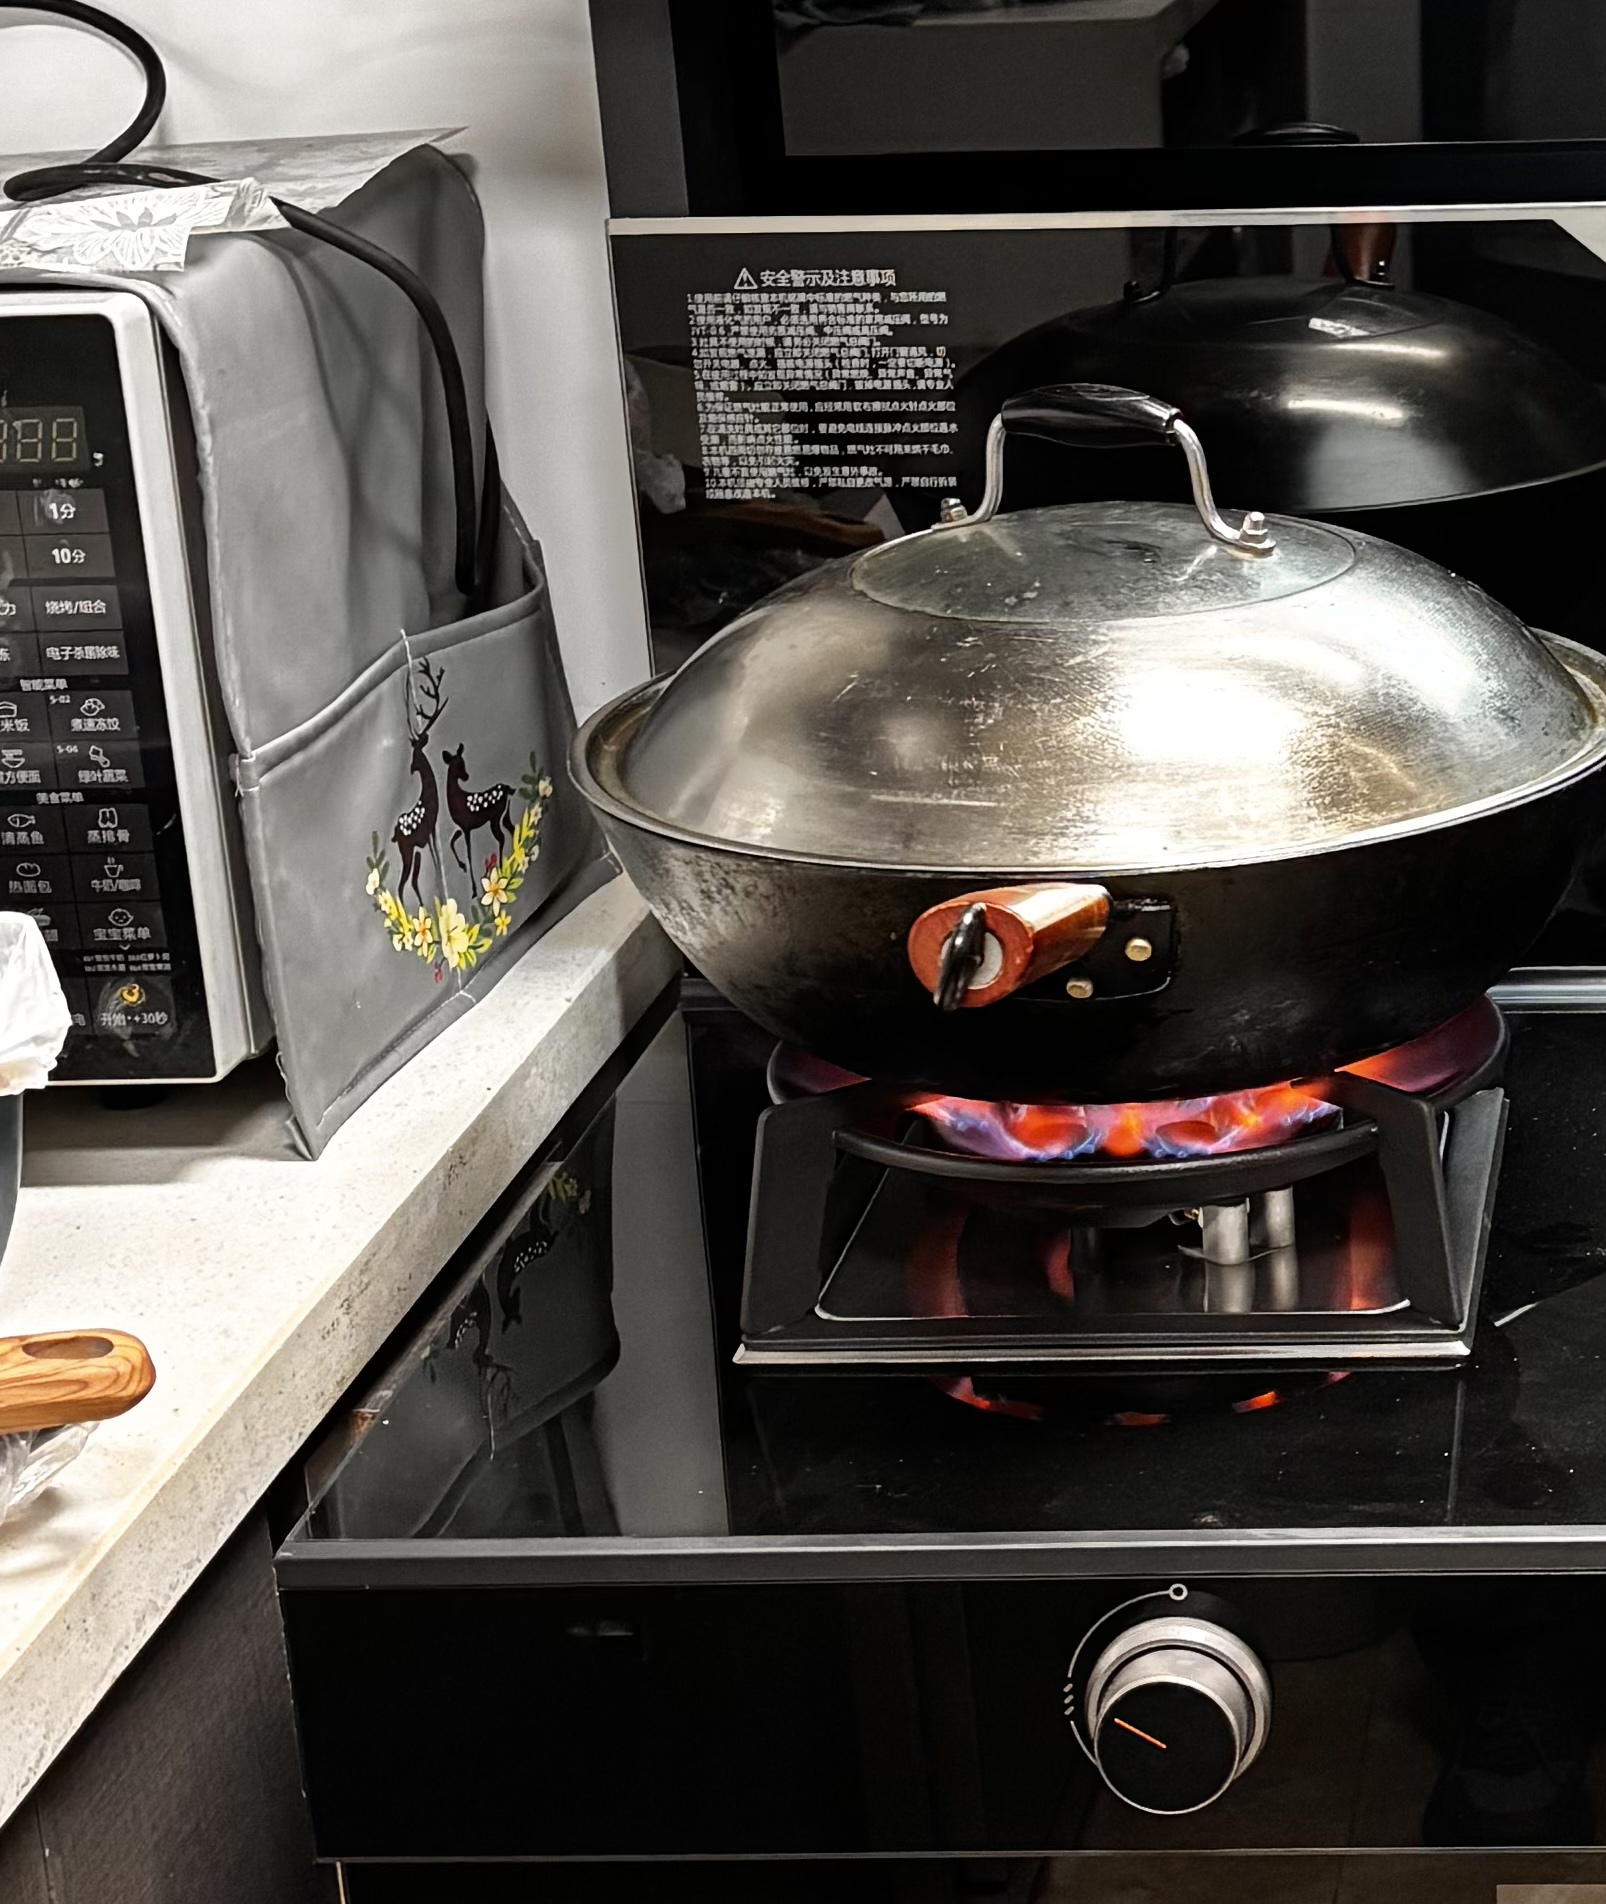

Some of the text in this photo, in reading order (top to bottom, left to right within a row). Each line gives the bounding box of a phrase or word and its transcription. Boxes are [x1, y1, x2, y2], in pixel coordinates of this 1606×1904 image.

[760, 268, 896, 288] 安全警示及注意事项
[49, 502, 76, 520] 1分
[52, 547, 86, 564] 10分
